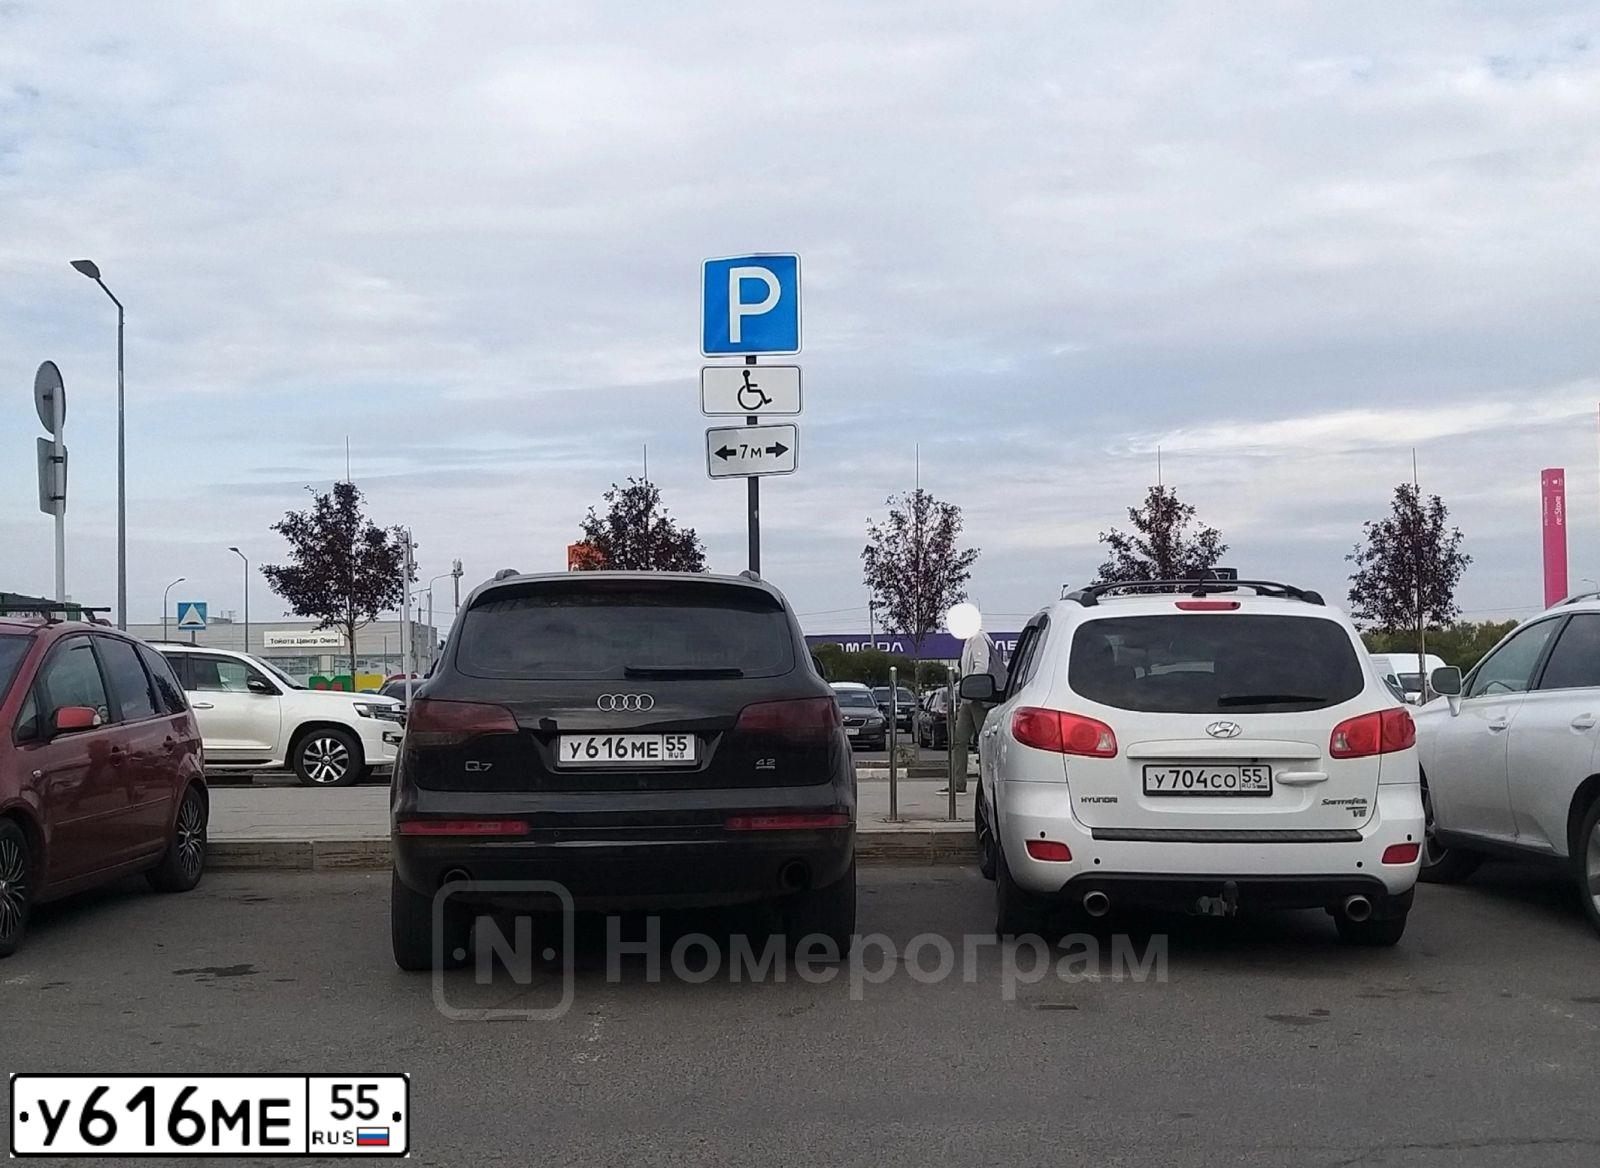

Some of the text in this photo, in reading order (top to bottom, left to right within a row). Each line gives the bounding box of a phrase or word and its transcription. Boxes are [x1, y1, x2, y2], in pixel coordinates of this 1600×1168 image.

[729, 267, 782, 343] P
[665, 736, 687, 751] 55
[465, 760, 492, 771] Q7
[1242, 768, 1262, 783] 55
[1352, 809, 1367, 818] V6
